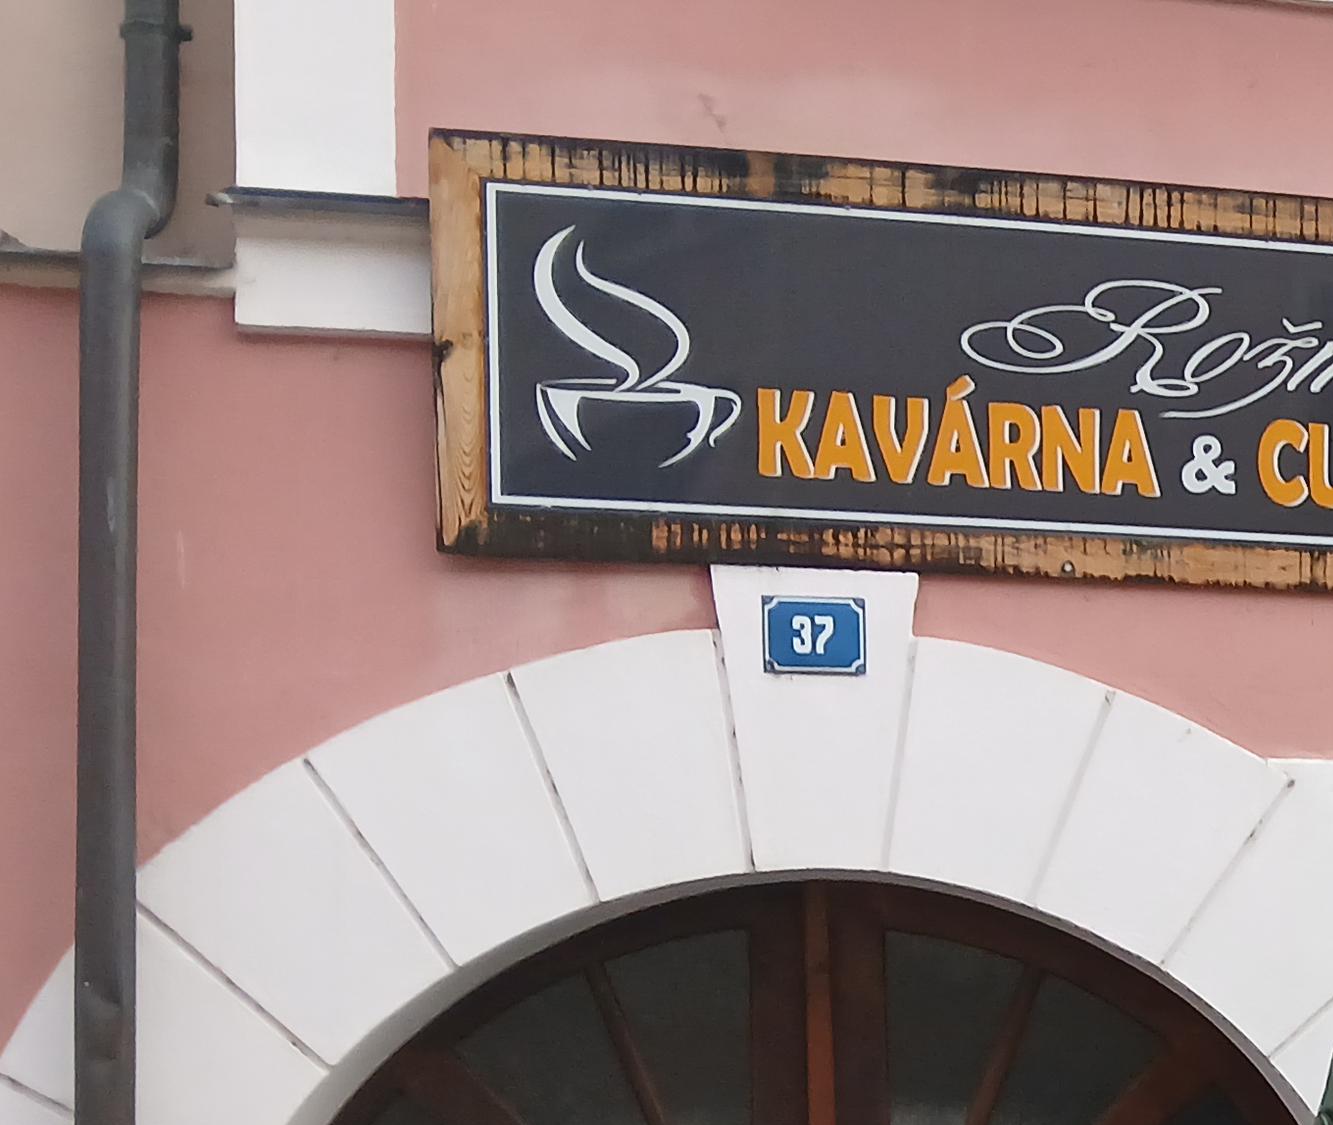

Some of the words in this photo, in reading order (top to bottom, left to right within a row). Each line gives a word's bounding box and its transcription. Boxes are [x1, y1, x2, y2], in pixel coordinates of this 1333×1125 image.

[757, 374, 1162, 498] KAVÁRNA
[1181, 434, 1237, 495] &
[791, 614, 835, 655] 37
